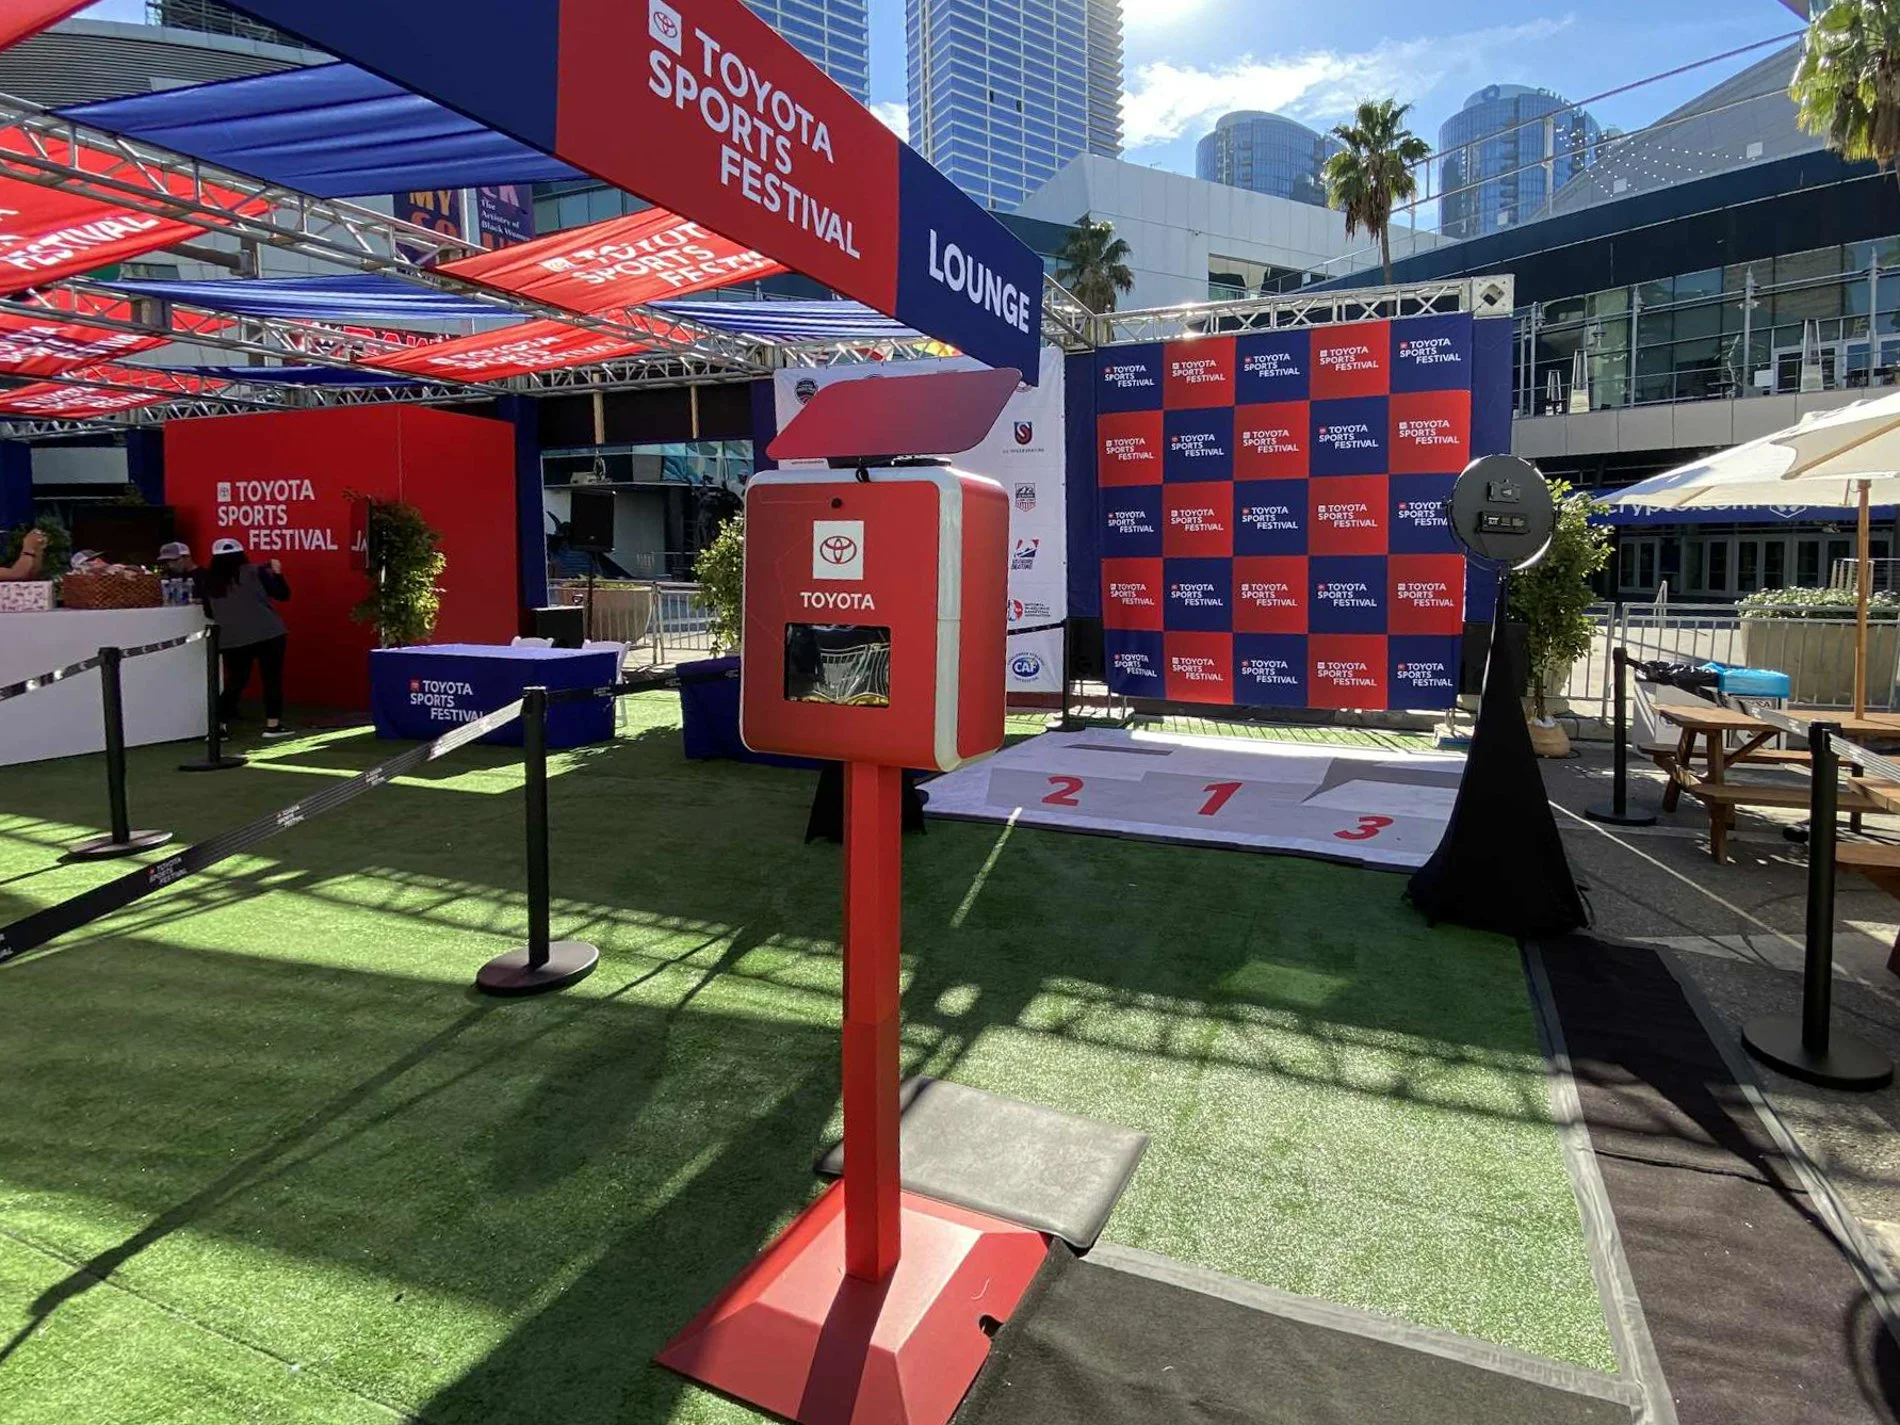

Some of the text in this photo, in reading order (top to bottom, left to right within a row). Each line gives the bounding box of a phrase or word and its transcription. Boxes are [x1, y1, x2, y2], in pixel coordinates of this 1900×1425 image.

[695, 28, 834, 164] TOYOTA
[649, 50, 792, 175] SPORTS
[721, 144, 860, 259] FESTIVAL
[6, 216, 160, 271] FESTIVAL
[573, 221, 708, 264] TOYOT
[573, 245, 715, 284] SPORTS
[929, 229, 1029, 334] LOUNGE
[1410, 338, 1451, 348] TOYOTA
[1330, 347, 1368, 355] TOYOTA
[1400, 348, 1436, 357] SPORTS
[1253, 353, 1290, 363] TOYOTA
[1320, 356, 1355, 365] SPORTS
[1416, 354, 1461, 363] FESTIVAL
[1181, 360, 1216, 368] TOYOTA
[1244, 362, 1277, 371] SPORTS
[1336, 361, 1378, 371] FESTIVAL
[1113, 365, 1146, 373] TOYOTA
[1172, 368, 1204, 377] SPORTS
[1259, 368, 1300, 377] FESTIVAL
[1105, 373, 1135, 381] SPORTS
[1186, 374, 1225, 383] FESTIVAL
[1118, 379, 1154, 387] FESTIVAL
[1410, 420, 1449, 428] TOYOTA
[1329, 425, 1368, 433] TOYOTA
[1399, 429, 1436, 437] SPORTS
[1181, 434, 1215, 442] TOYOTA
[1253, 430, 1289, 438] TOYOTA
[1319, 434, 1354, 442] SPORTS
[1114, 438, 1145, 446] TOYOTA
[1172, 442, 1202, 450] SPORTS
[1243, 438, 1277, 446] SPORTS
[1334, 440, 1378, 449] FESTIVAL
[1106, 446, 1134, 454] SPORTS
[1185, 448, 1224, 456] FESTIVAL
[1258, 444, 1299, 453] FESTIVAL
[1119, 452, 1153, 460] FESTIVAL
[236, 479, 315, 502] TOYOTA
[1328, 504, 1367, 512] TOYOTA
[1409, 502, 1442, 510] TOYOT
[218, 504, 287, 526] SPORTS
[1180, 509, 1214, 517] TOYOTA
[1399, 510, 1435, 518] SPORTS
[1257, 521, 1298, 530] FESTIVAL
[1334, 519, 1377, 528] FESTIVAL
[1415, 518, 1447, 526] FESTIV
[1185, 523, 1223, 531] FESTIVAL
[249, 529, 337, 550] FESTIVAL
[800, 592, 875, 610] TOYOTA
[1333, 599, 1377, 607] FESTIVAL
[1414, 599, 1454, 607] FESTIVAL
[1121, 654, 1148, 662] TOYOTA
[1014, 661, 1037, 673] CAF
[1127, 668, 1157, 677] FESTIVAL
[1186, 672, 1223, 681] FESTIVAL
[1318, 670, 1353, 678] SPORTS
[1256, 675, 1298, 683] FESTIVAL
[1333, 678, 1377, 686] FESTIVAL
[422, 680, 473, 695] TOYOTA
[410, 693, 455, 707] SPORTS
[1042, 775, 1084, 806] 2
[1198, 781, 1243, 816] 1
[1333, 816, 1394, 840] 3
